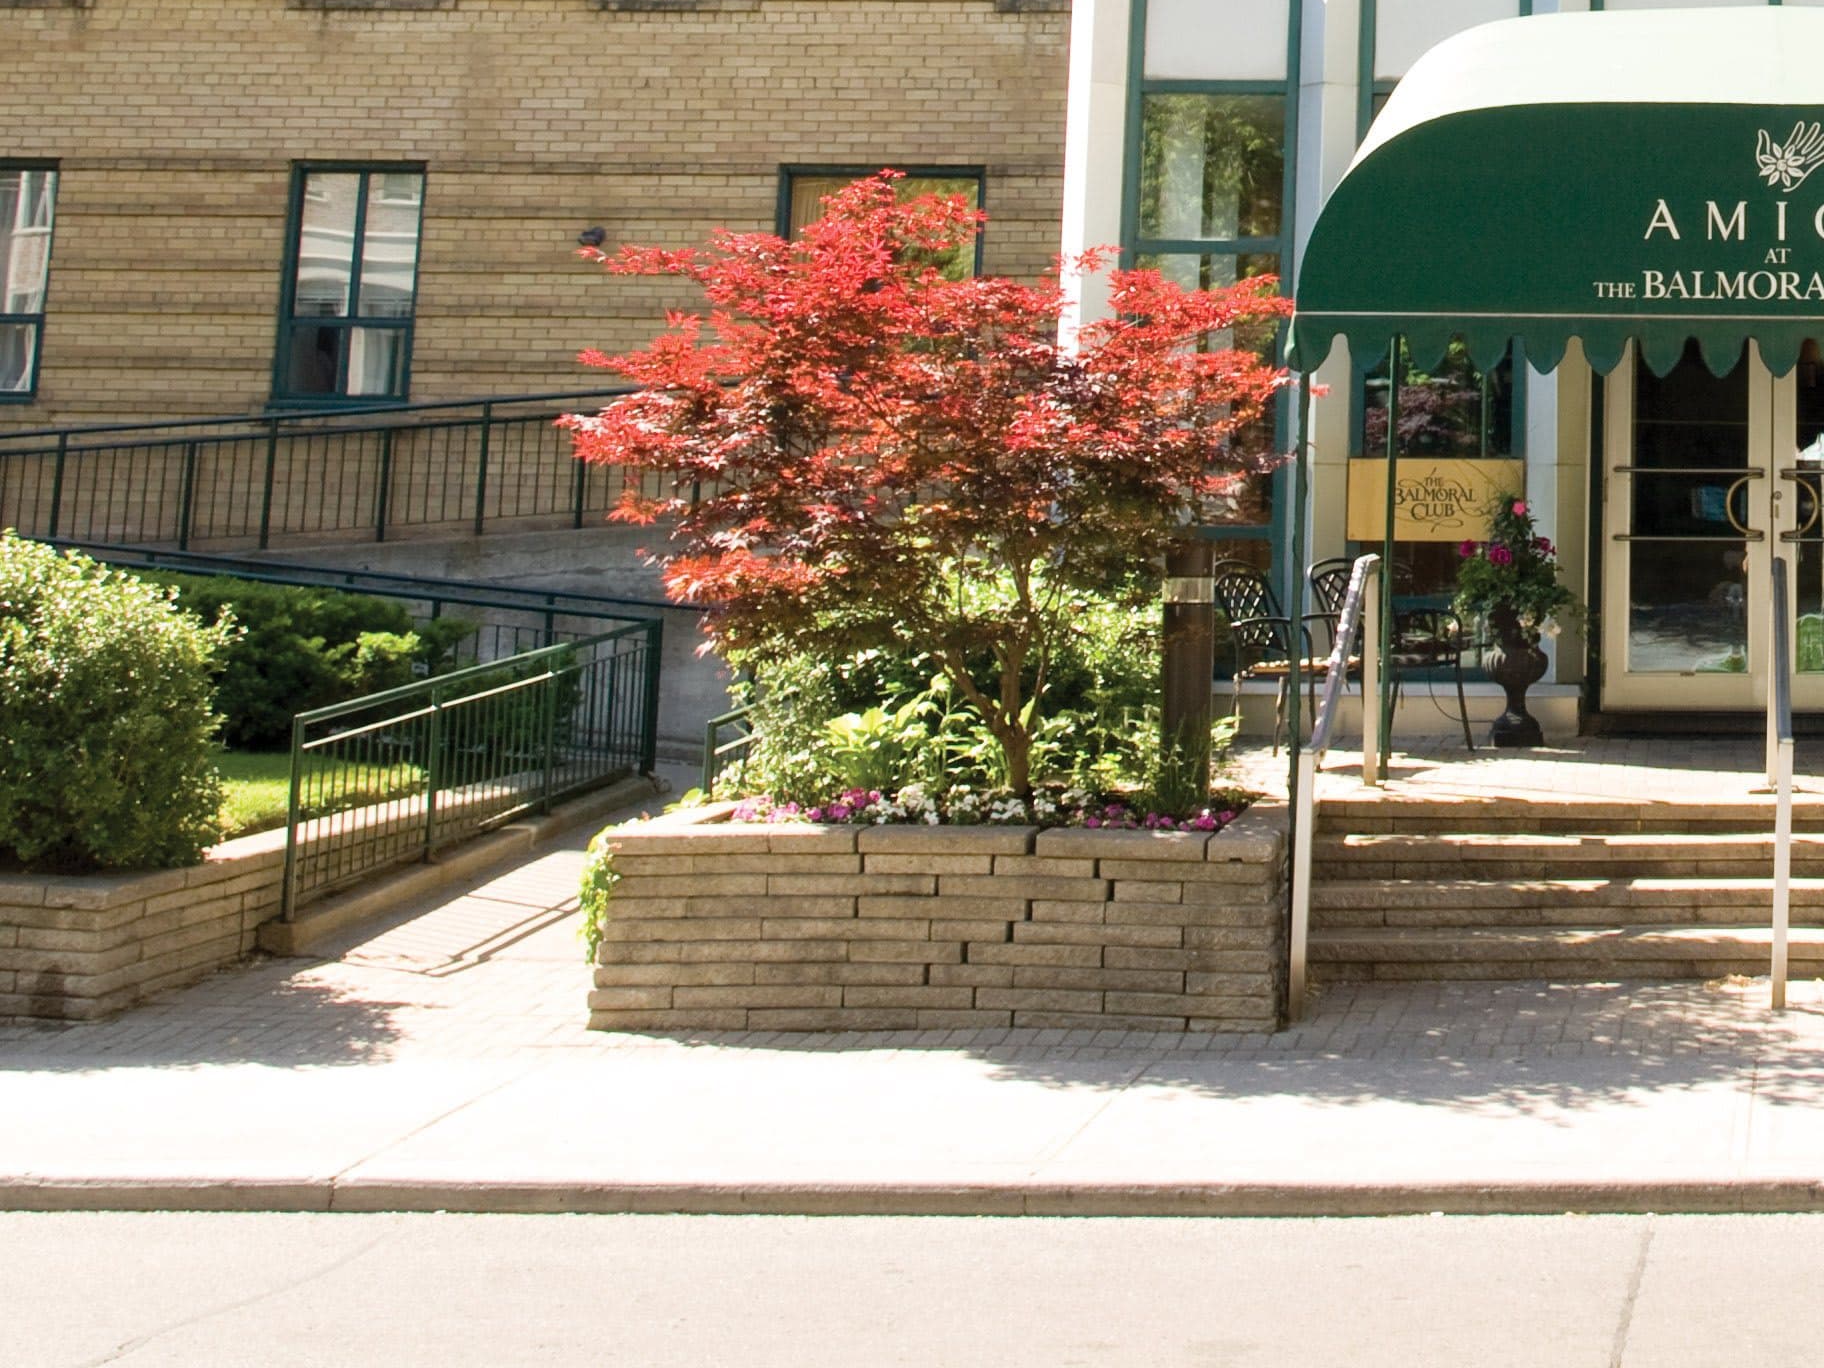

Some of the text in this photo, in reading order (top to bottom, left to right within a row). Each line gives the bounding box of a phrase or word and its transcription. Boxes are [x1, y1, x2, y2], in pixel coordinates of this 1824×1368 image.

[1764, 248, 1791, 264] AT
[1593, 282, 1636, 299] THE
[1424, 476, 1445, 487] THE
[1411, 503, 1455, 520] CLUB
